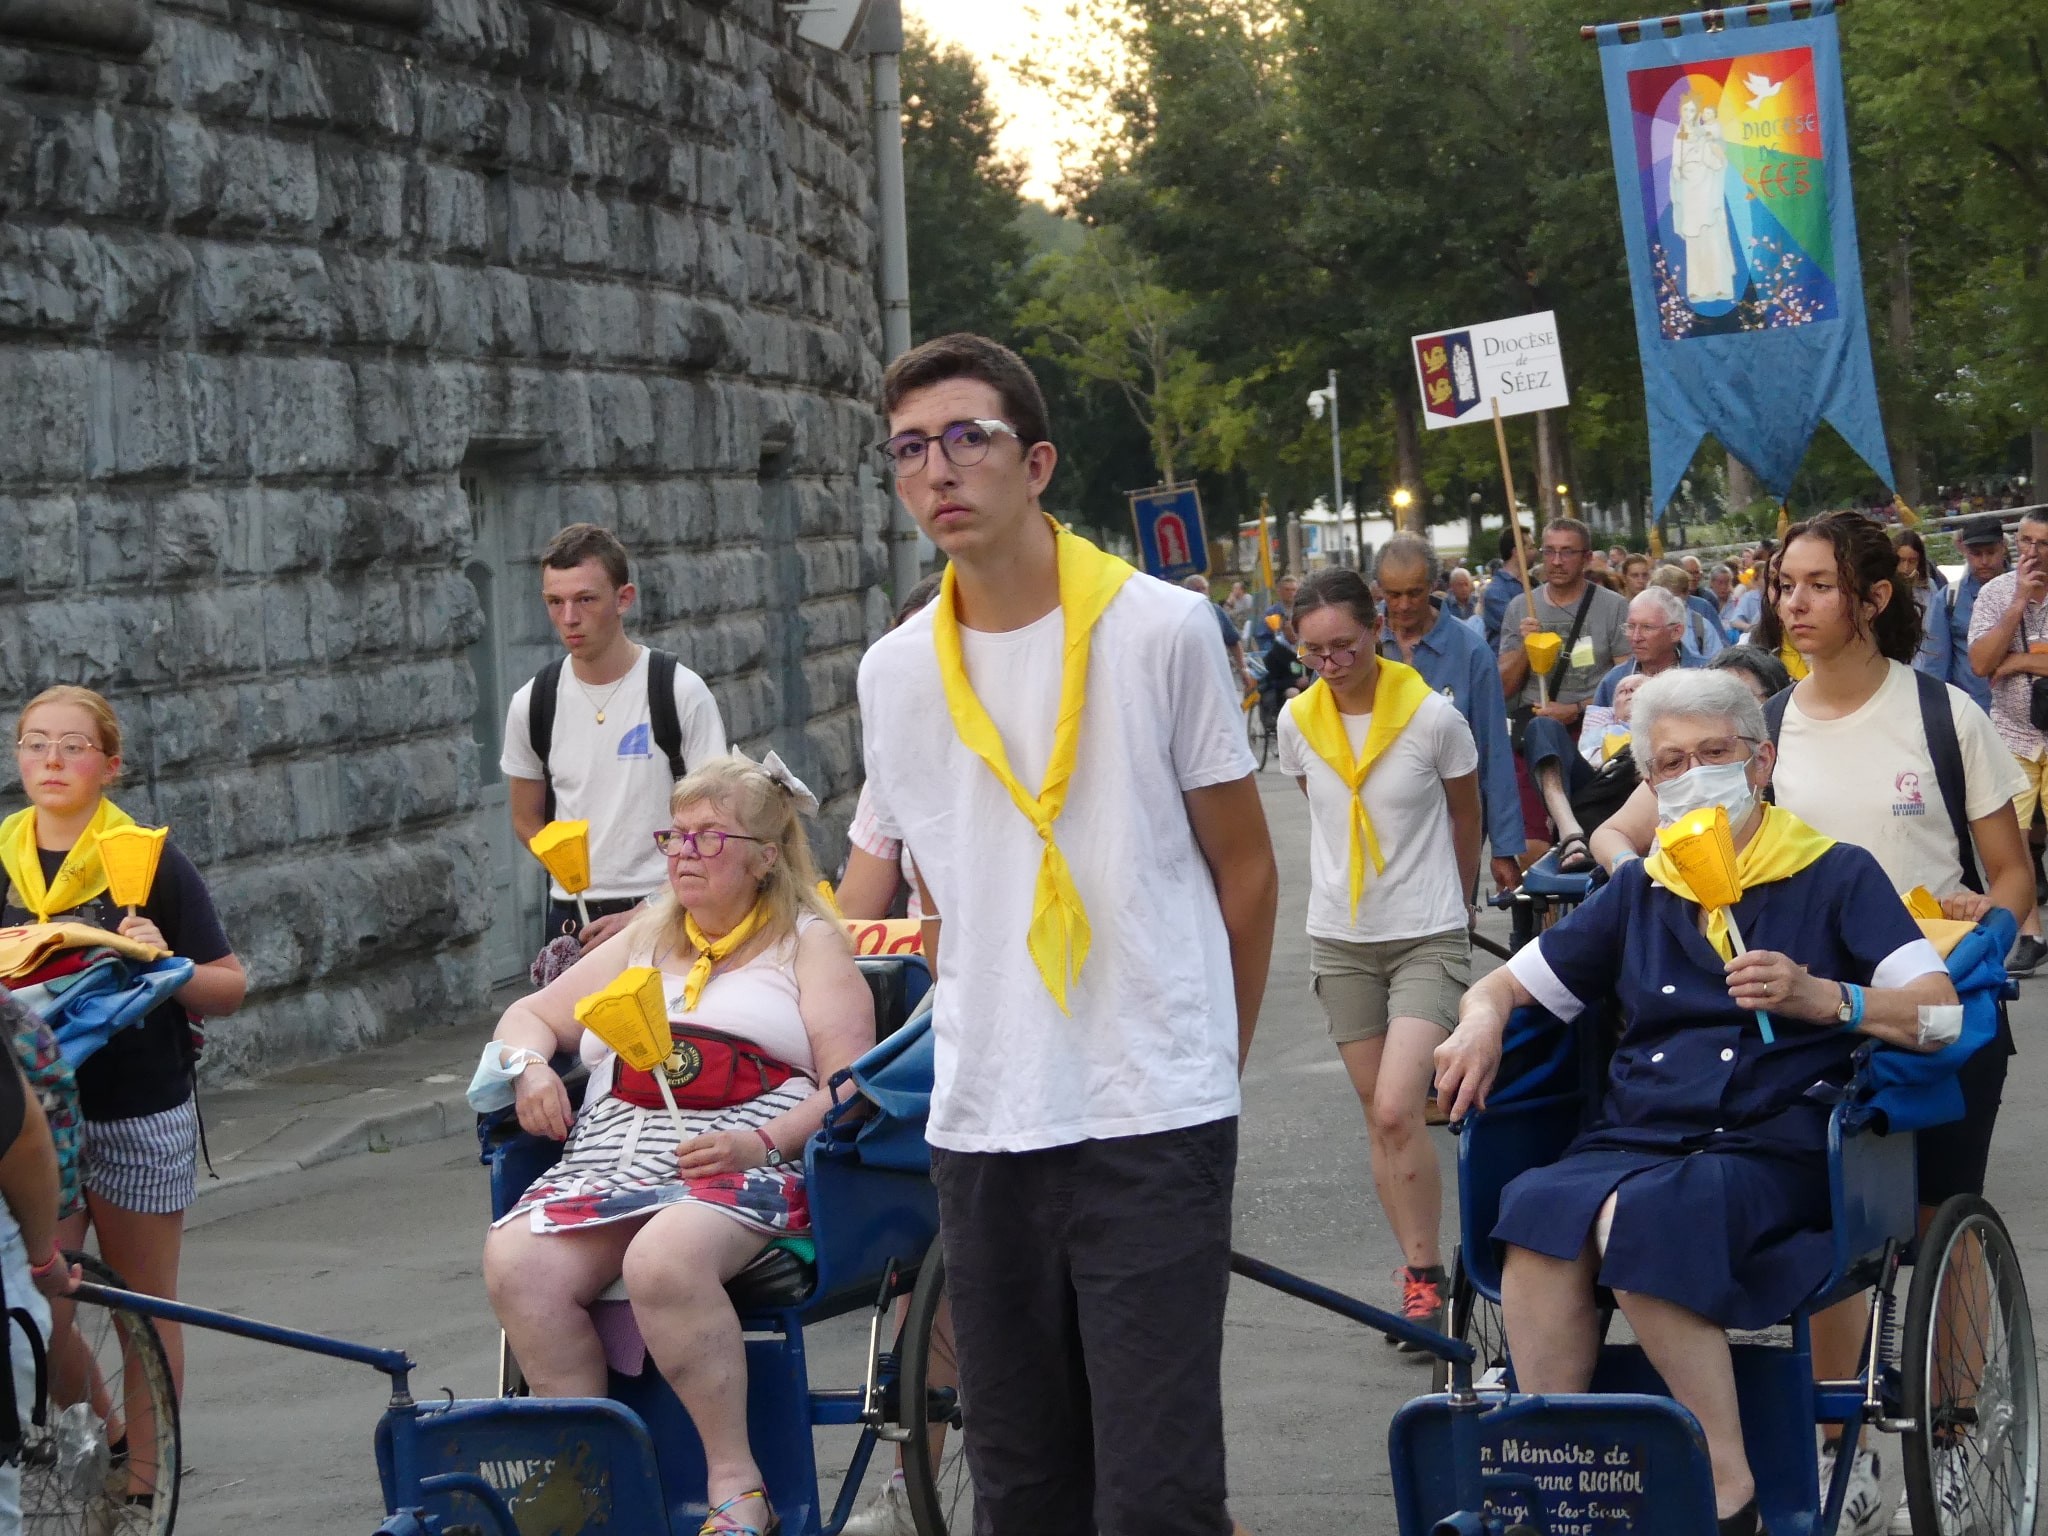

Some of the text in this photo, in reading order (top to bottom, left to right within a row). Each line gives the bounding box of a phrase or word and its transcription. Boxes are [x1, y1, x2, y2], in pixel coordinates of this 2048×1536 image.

[1515, 353, 1528, 367] de
[1501, 371, 1552, 395] SÉEZ
[1502, 1439, 1596, 1464] Mémoire
[1604, 1445, 1631, 1465] de
